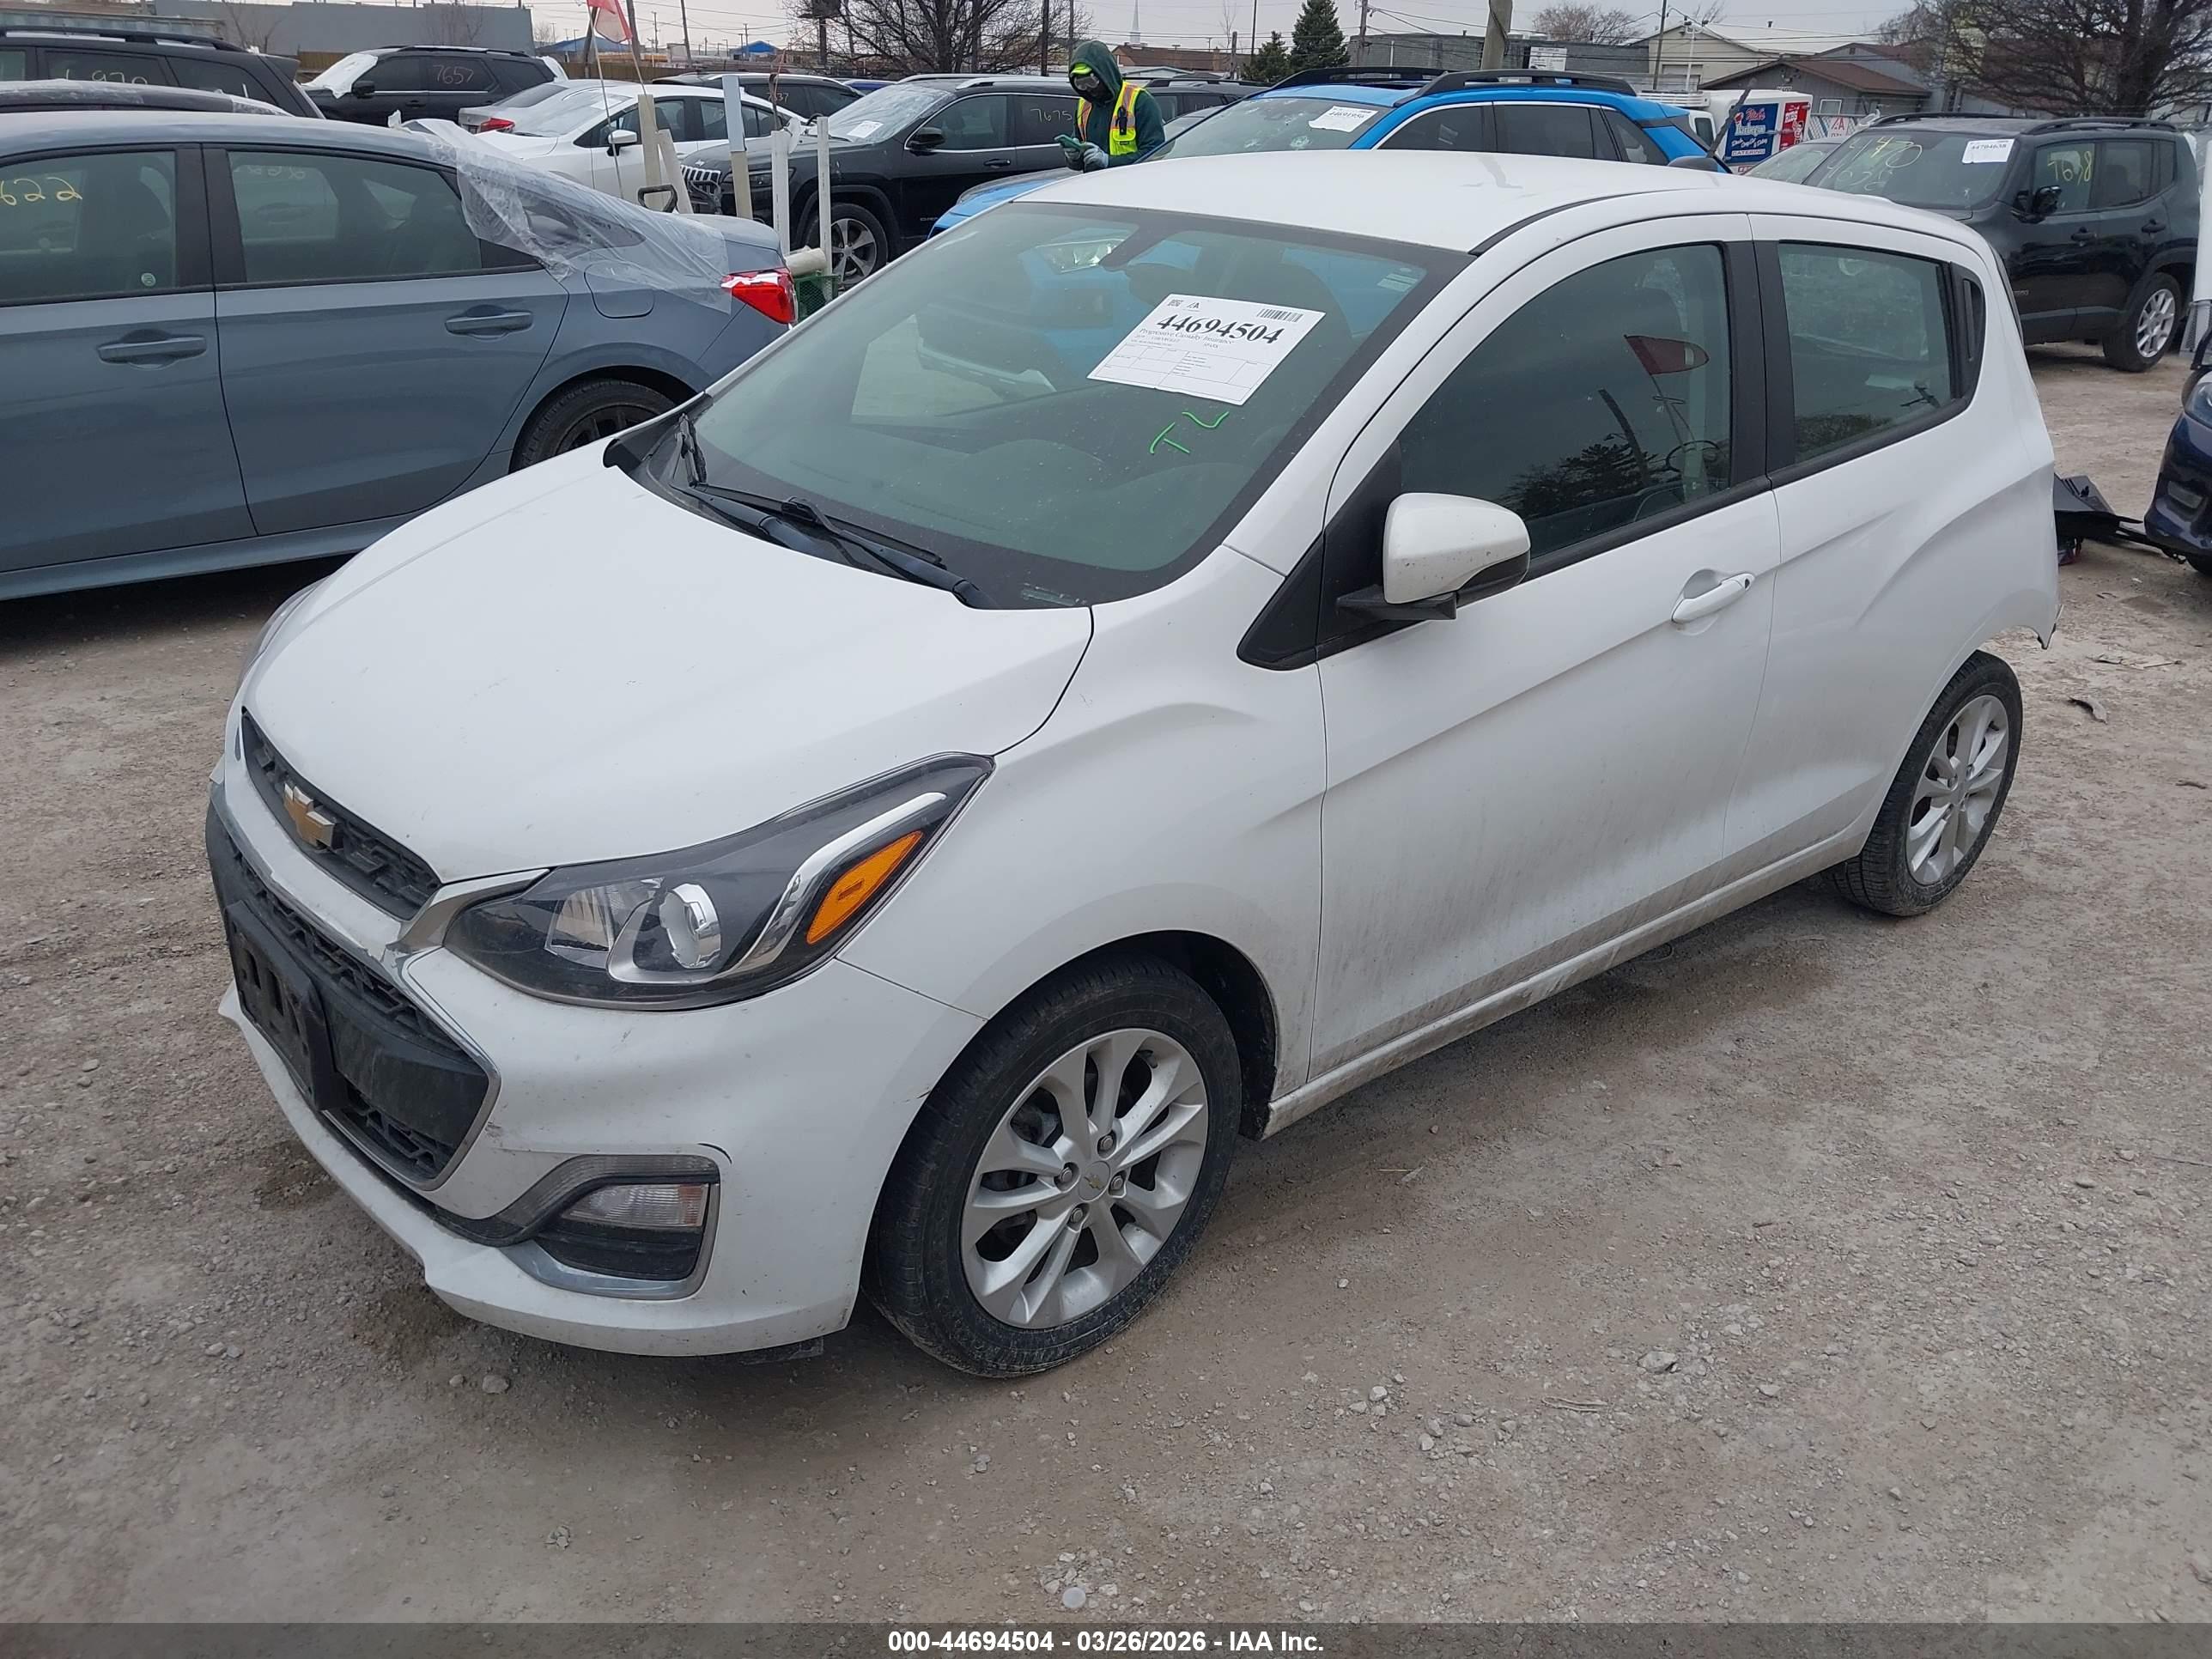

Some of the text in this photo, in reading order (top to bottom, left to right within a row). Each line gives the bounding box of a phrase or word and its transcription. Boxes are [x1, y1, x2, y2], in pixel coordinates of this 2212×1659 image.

[433, 64, 474, 84] 7657
[1030, 108, 1073, 123] 7675
[1157, 313, 1285, 344] 44694504
